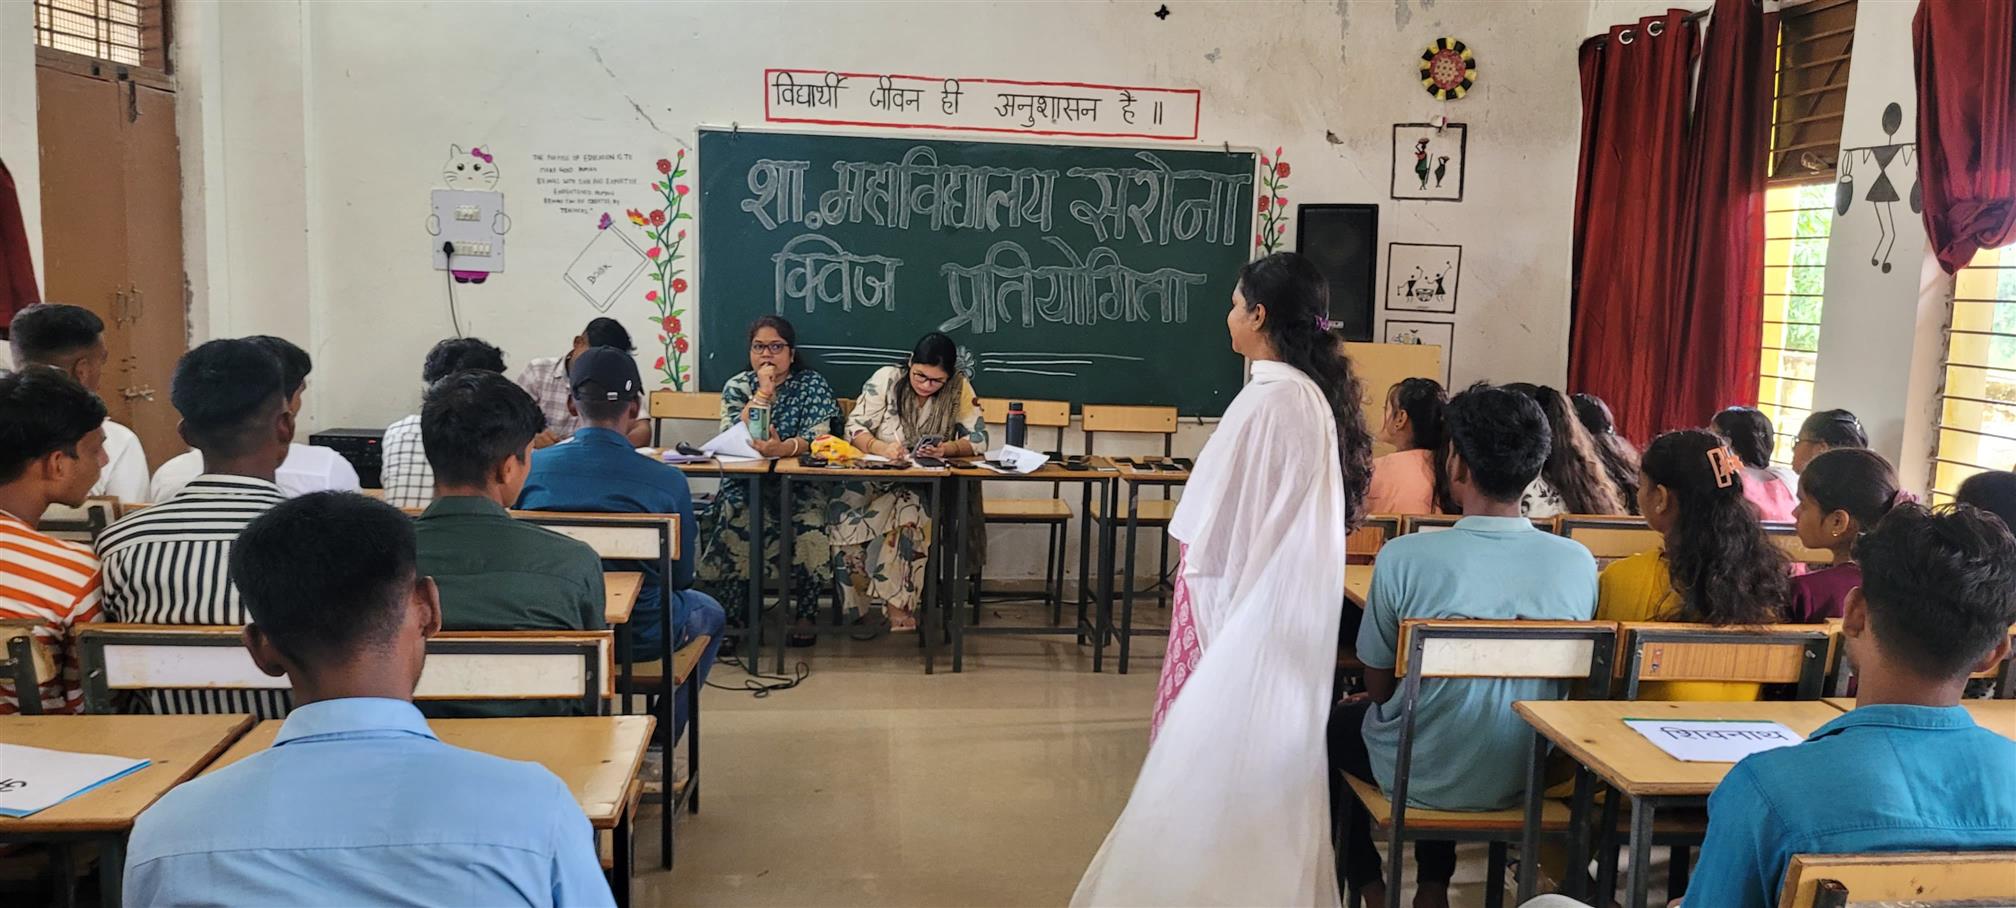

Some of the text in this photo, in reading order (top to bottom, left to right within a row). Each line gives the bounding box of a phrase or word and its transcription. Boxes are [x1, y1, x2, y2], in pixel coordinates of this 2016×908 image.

[772, 72, 849, 109] विद्यार्थी
[869, 75, 925, 113] जीवन
[941, 78, 964, 115] ही
[994, 93, 1103, 128] अनुशासन
[1119, 90, 1138, 125] है
[1066, 151, 1253, 246] सरोना
[938, 236, 1208, 334] प्रतियोगिता
[1659, 726, 1789, 741] शिवनाथ
